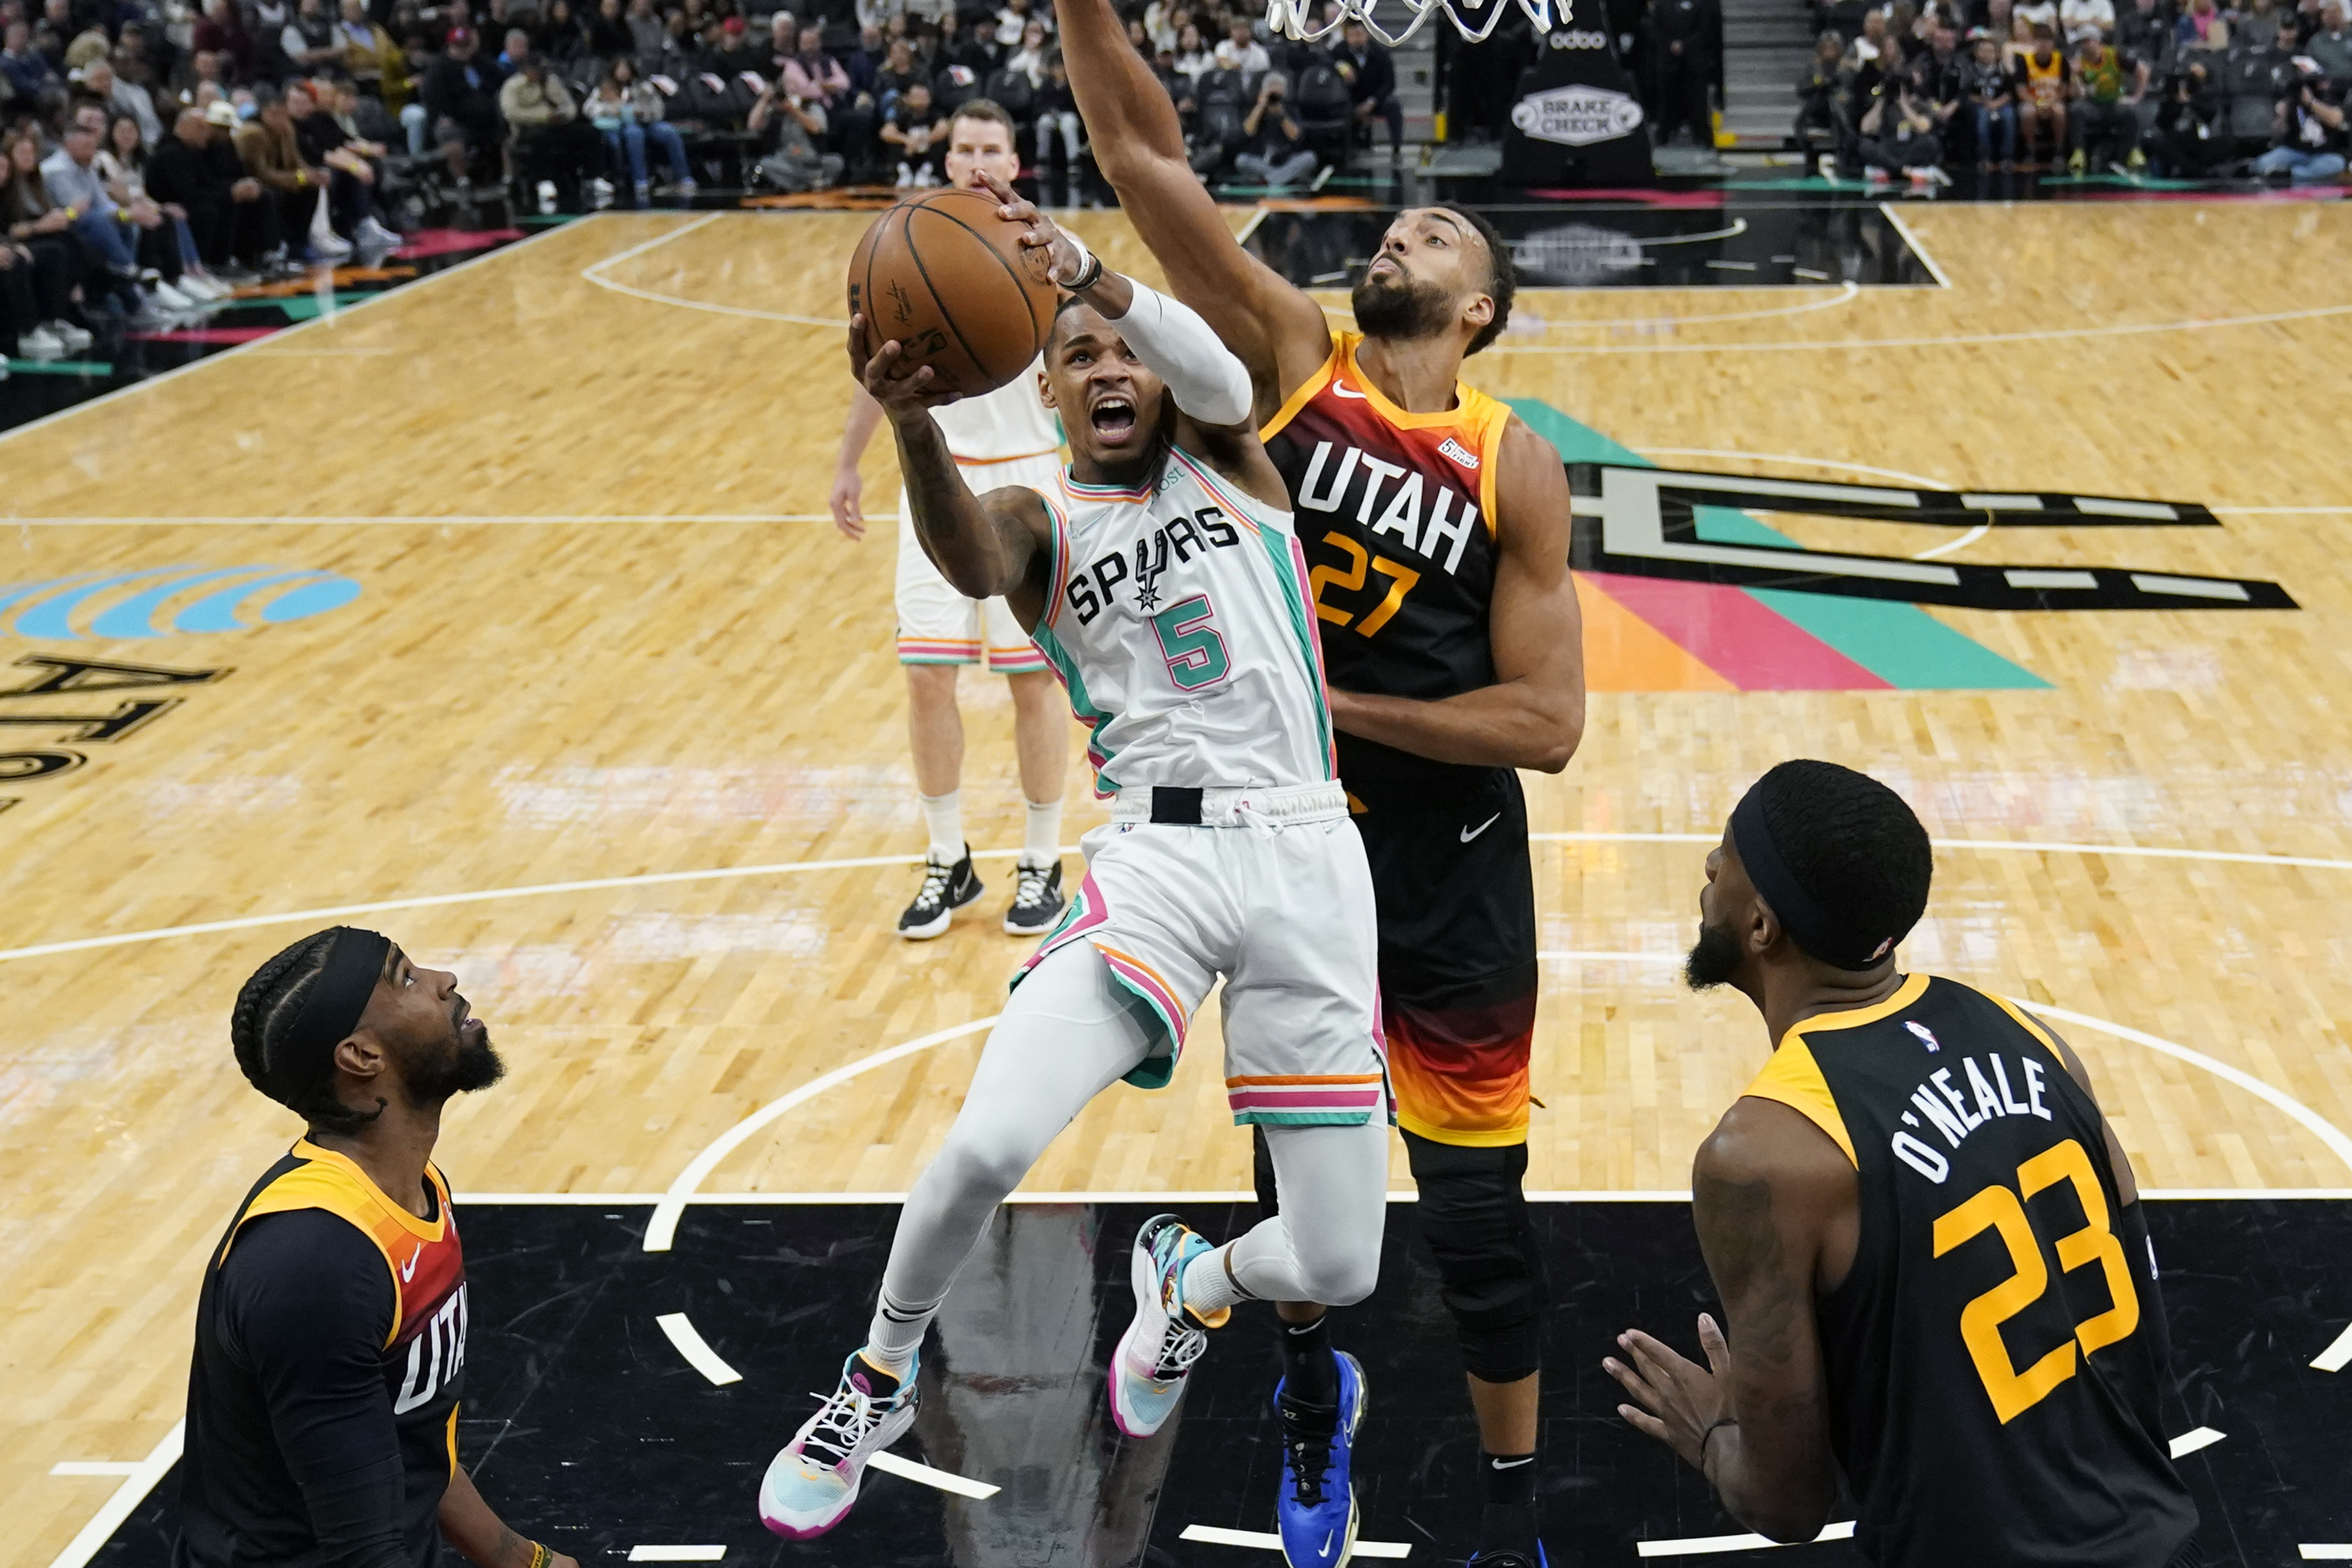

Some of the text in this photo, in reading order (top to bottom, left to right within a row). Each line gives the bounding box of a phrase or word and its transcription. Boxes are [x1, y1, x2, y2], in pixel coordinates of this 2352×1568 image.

[1549, 28, 1607, 50] odoo
[1542, 99, 1612, 115] BRAKE
[1542, 117, 1611, 134] CHECK
[1441, 439, 1455, 453] 5
[1298, 441, 1478, 575] UTAH
[1066, 508, 1239, 626] SPURS
[1309, 531, 1421, 637] 27
[1150, 595, 1231, 691] 5
[1891, 1053, 2052, 1185] O'NEALE
[1933, 1138, 2139, 1426] 23
[394, 1280, 468, 1415] UTA
